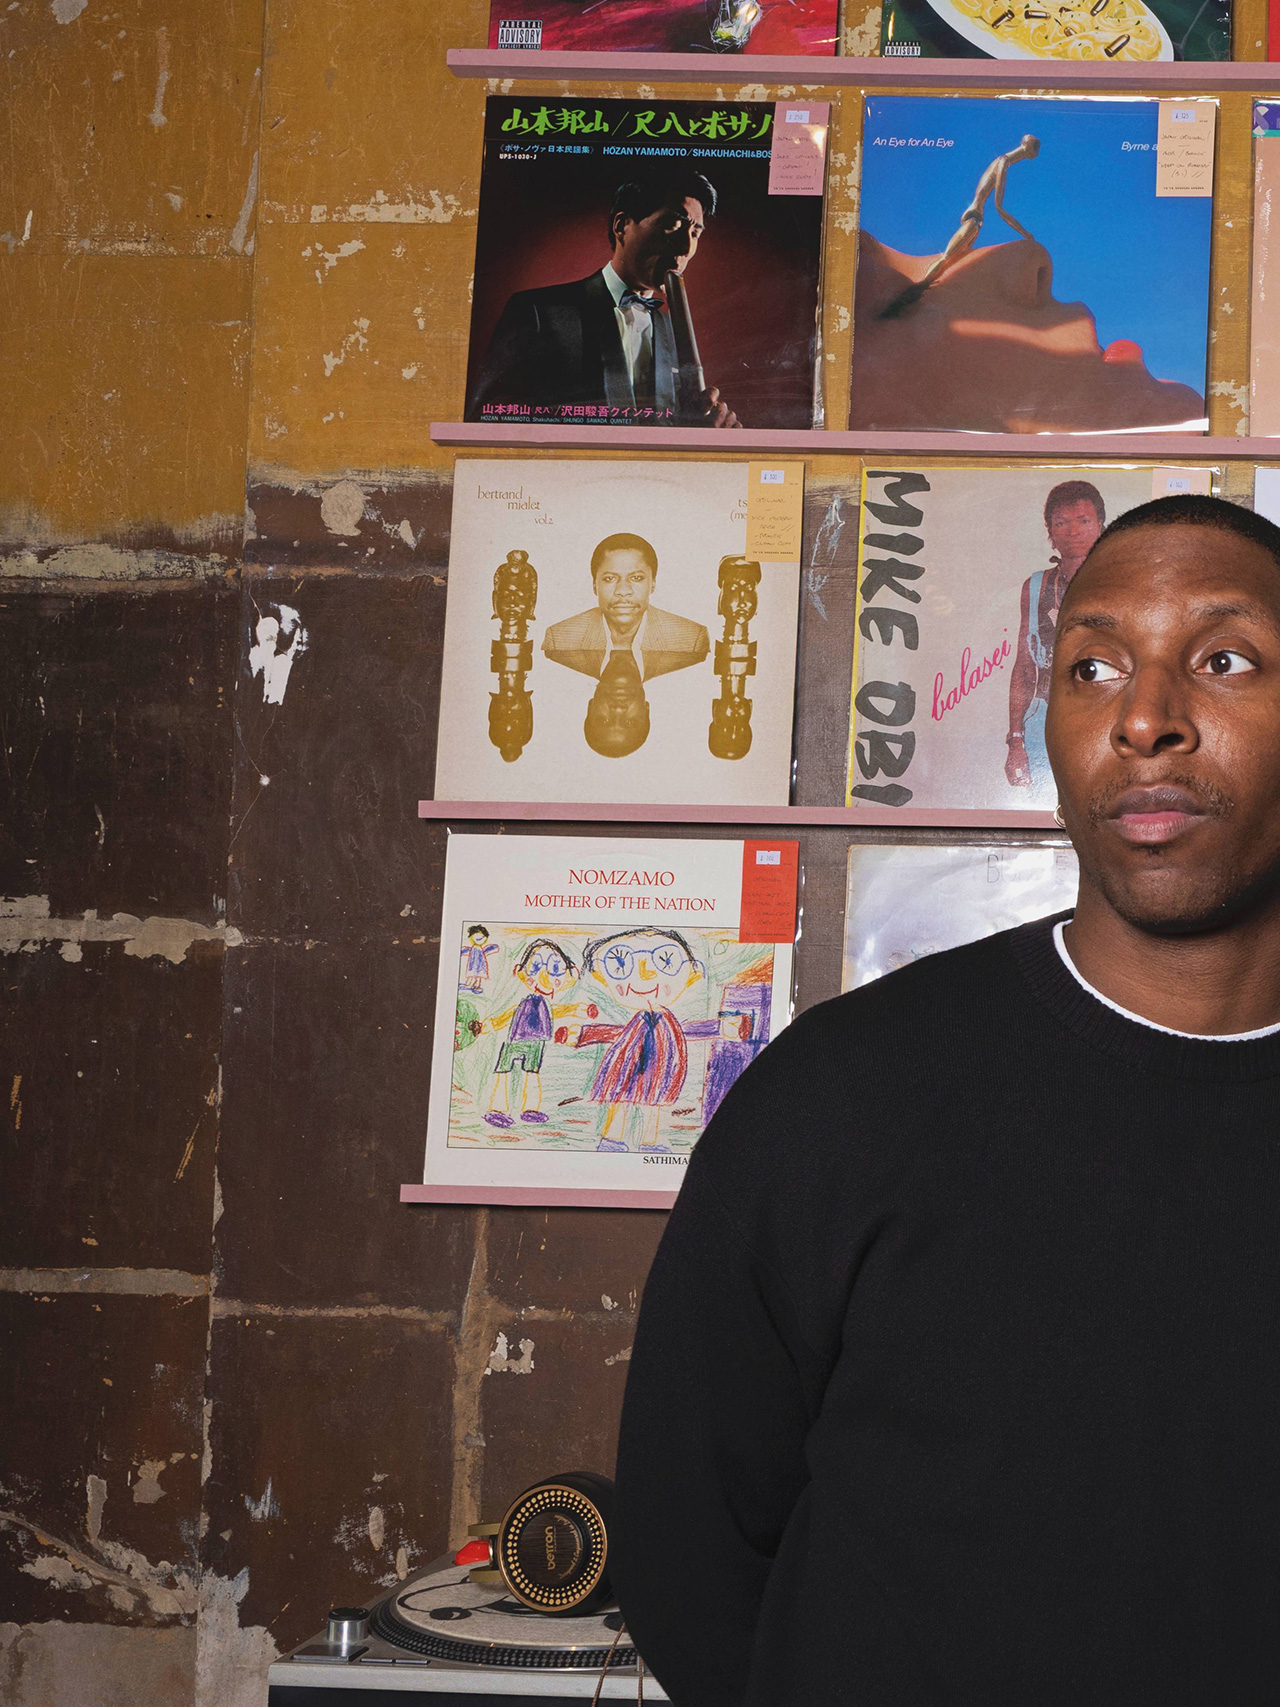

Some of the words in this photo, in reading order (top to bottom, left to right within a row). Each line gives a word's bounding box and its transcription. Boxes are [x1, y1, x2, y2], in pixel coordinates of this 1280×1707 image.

[500, 29, 540, 43] ADVISORY
[886, 46, 920, 55] ADVISORY
[873, 137, 887, 146] An
[889, 137, 906, 148] Eye
[908, 137, 921, 146] for
[921, 138, 935, 147] An
[936, 138, 955, 148] Eye
[1121, 141, 1150, 152] Byrne
[477, 485, 523, 500] bertrand
[507, 496, 541, 510] mialet
[859, 471, 931, 651] MIKE
[850, 681, 917, 807] OBI
[568, 869, 676, 887] NOMZAMO
[524, 894, 592, 909] MOTHER
[594, 895, 617, 909] OF
[619, 896, 651, 910] THE
[654, 897, 716, 912] NATION
[643, 1155, 688, 1165] SATHIMA
[544, 1525, 556, 1571] betron
